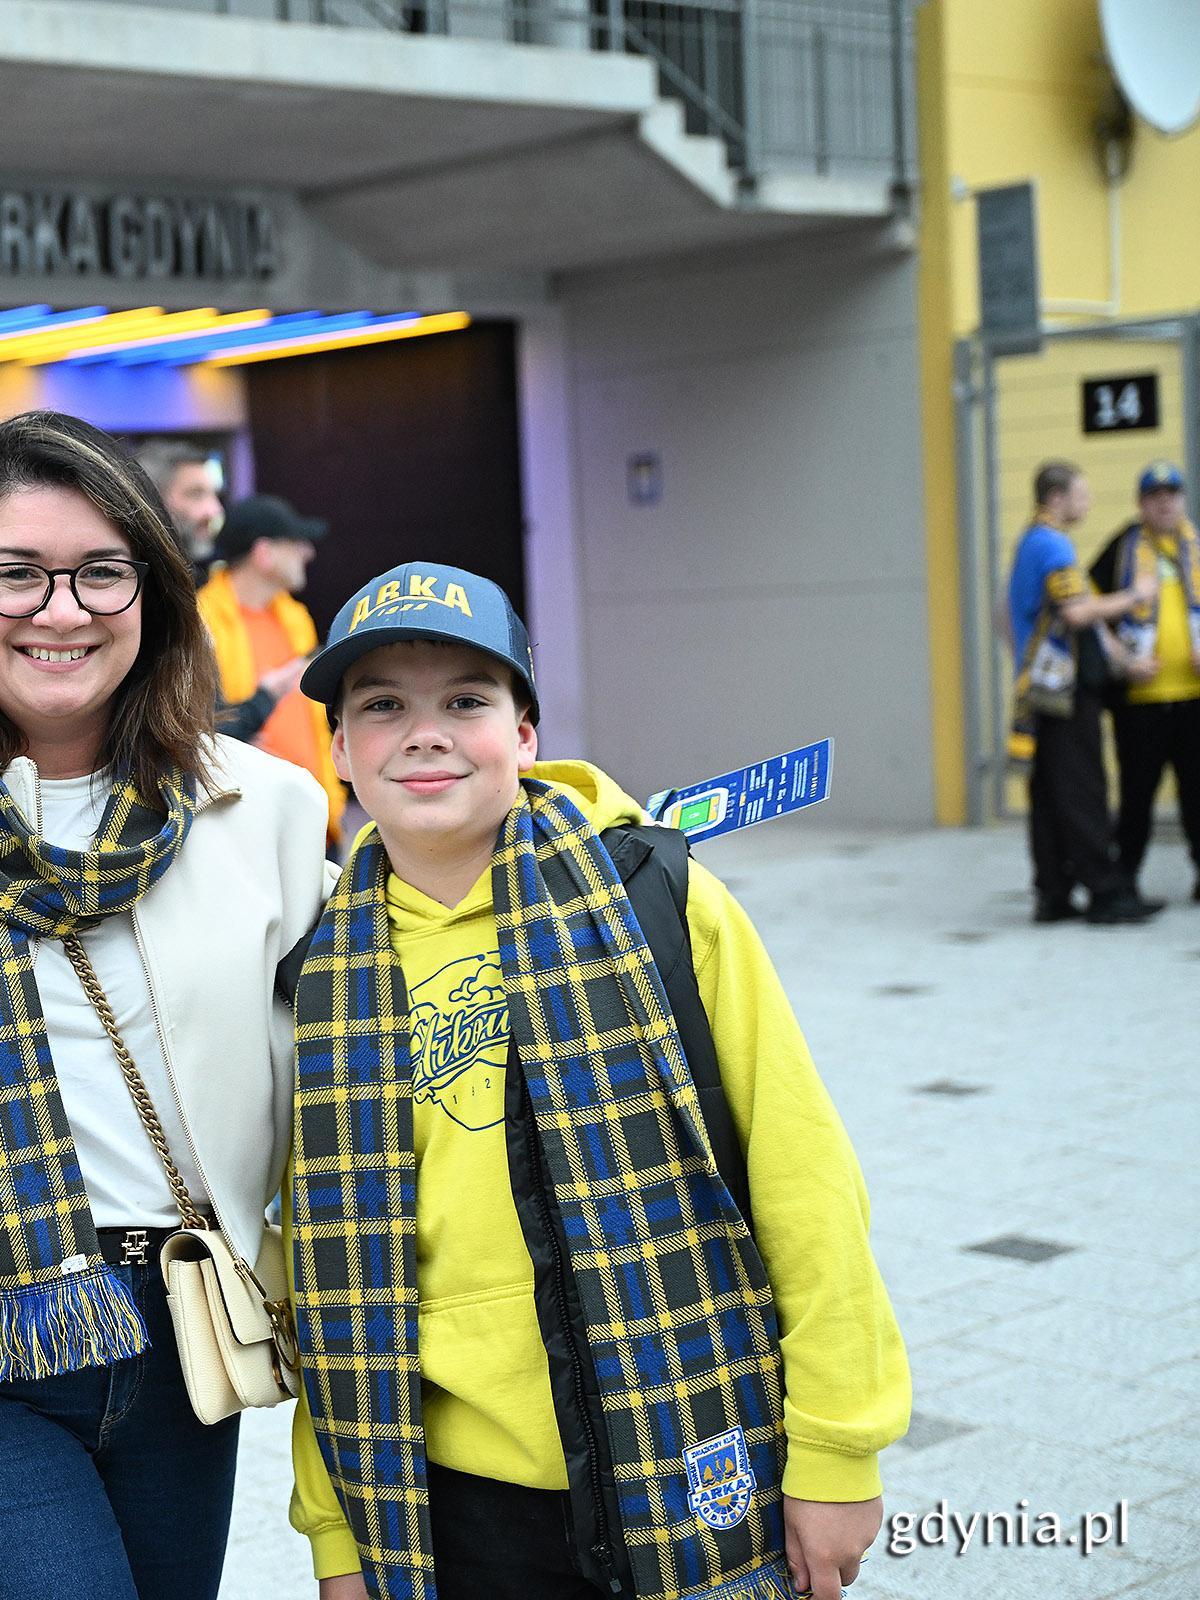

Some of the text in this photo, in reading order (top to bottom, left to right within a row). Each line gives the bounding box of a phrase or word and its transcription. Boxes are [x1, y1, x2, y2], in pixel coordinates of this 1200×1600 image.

[1094, 382, 1140, 428] 14
[348, 574, 473, 634] ARKA
[699, 1478, 747, 1504] ARKA
